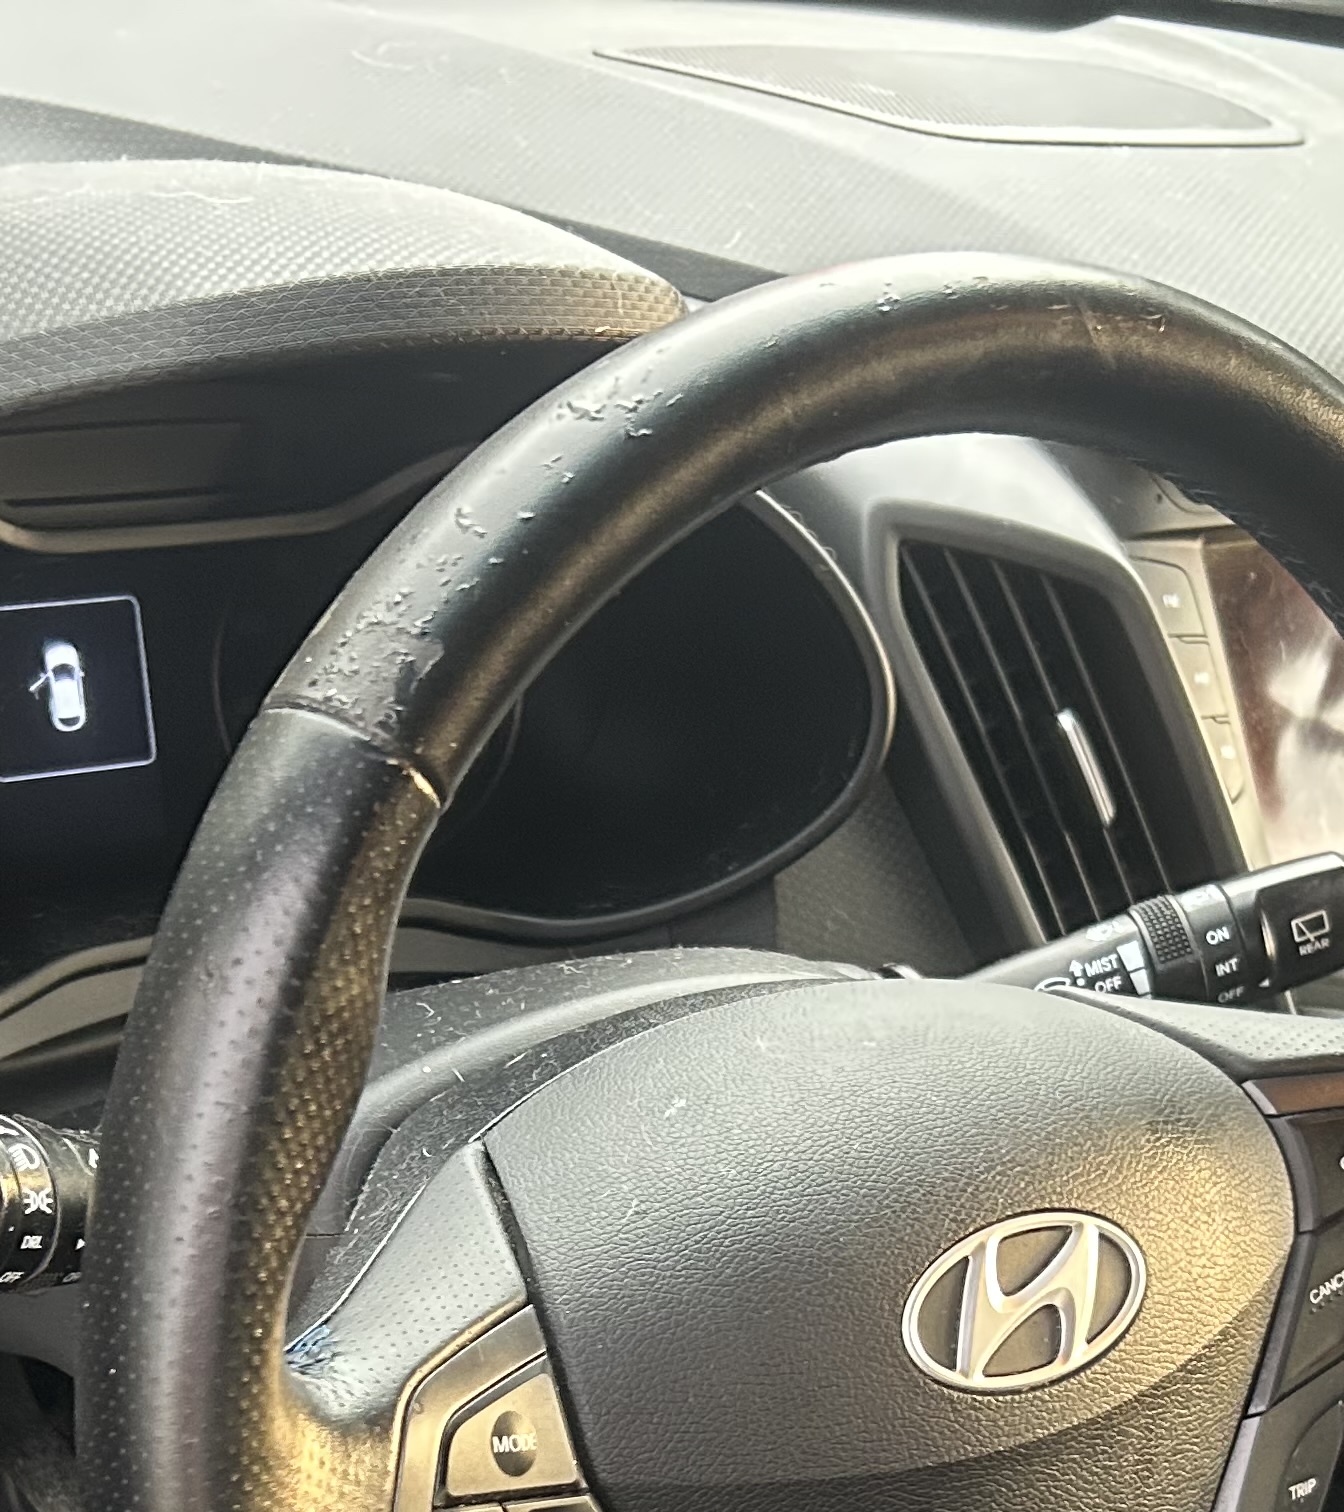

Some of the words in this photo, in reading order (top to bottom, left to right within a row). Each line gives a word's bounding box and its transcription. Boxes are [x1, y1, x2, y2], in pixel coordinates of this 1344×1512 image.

[1205, 925, 1231, 946] ON
[1299, 938, 1330, 957] REAR
[1084, 953, 1118, 977] MIST
[1215, 957, 1240, 977] INT
[1094, 976, 1122, 993] OFF
[1217, 985, 1245, 1003] OFF
[492, 1432, 538, 1453] MODE
[1287, 1477, 1317, 1501] TRIP
